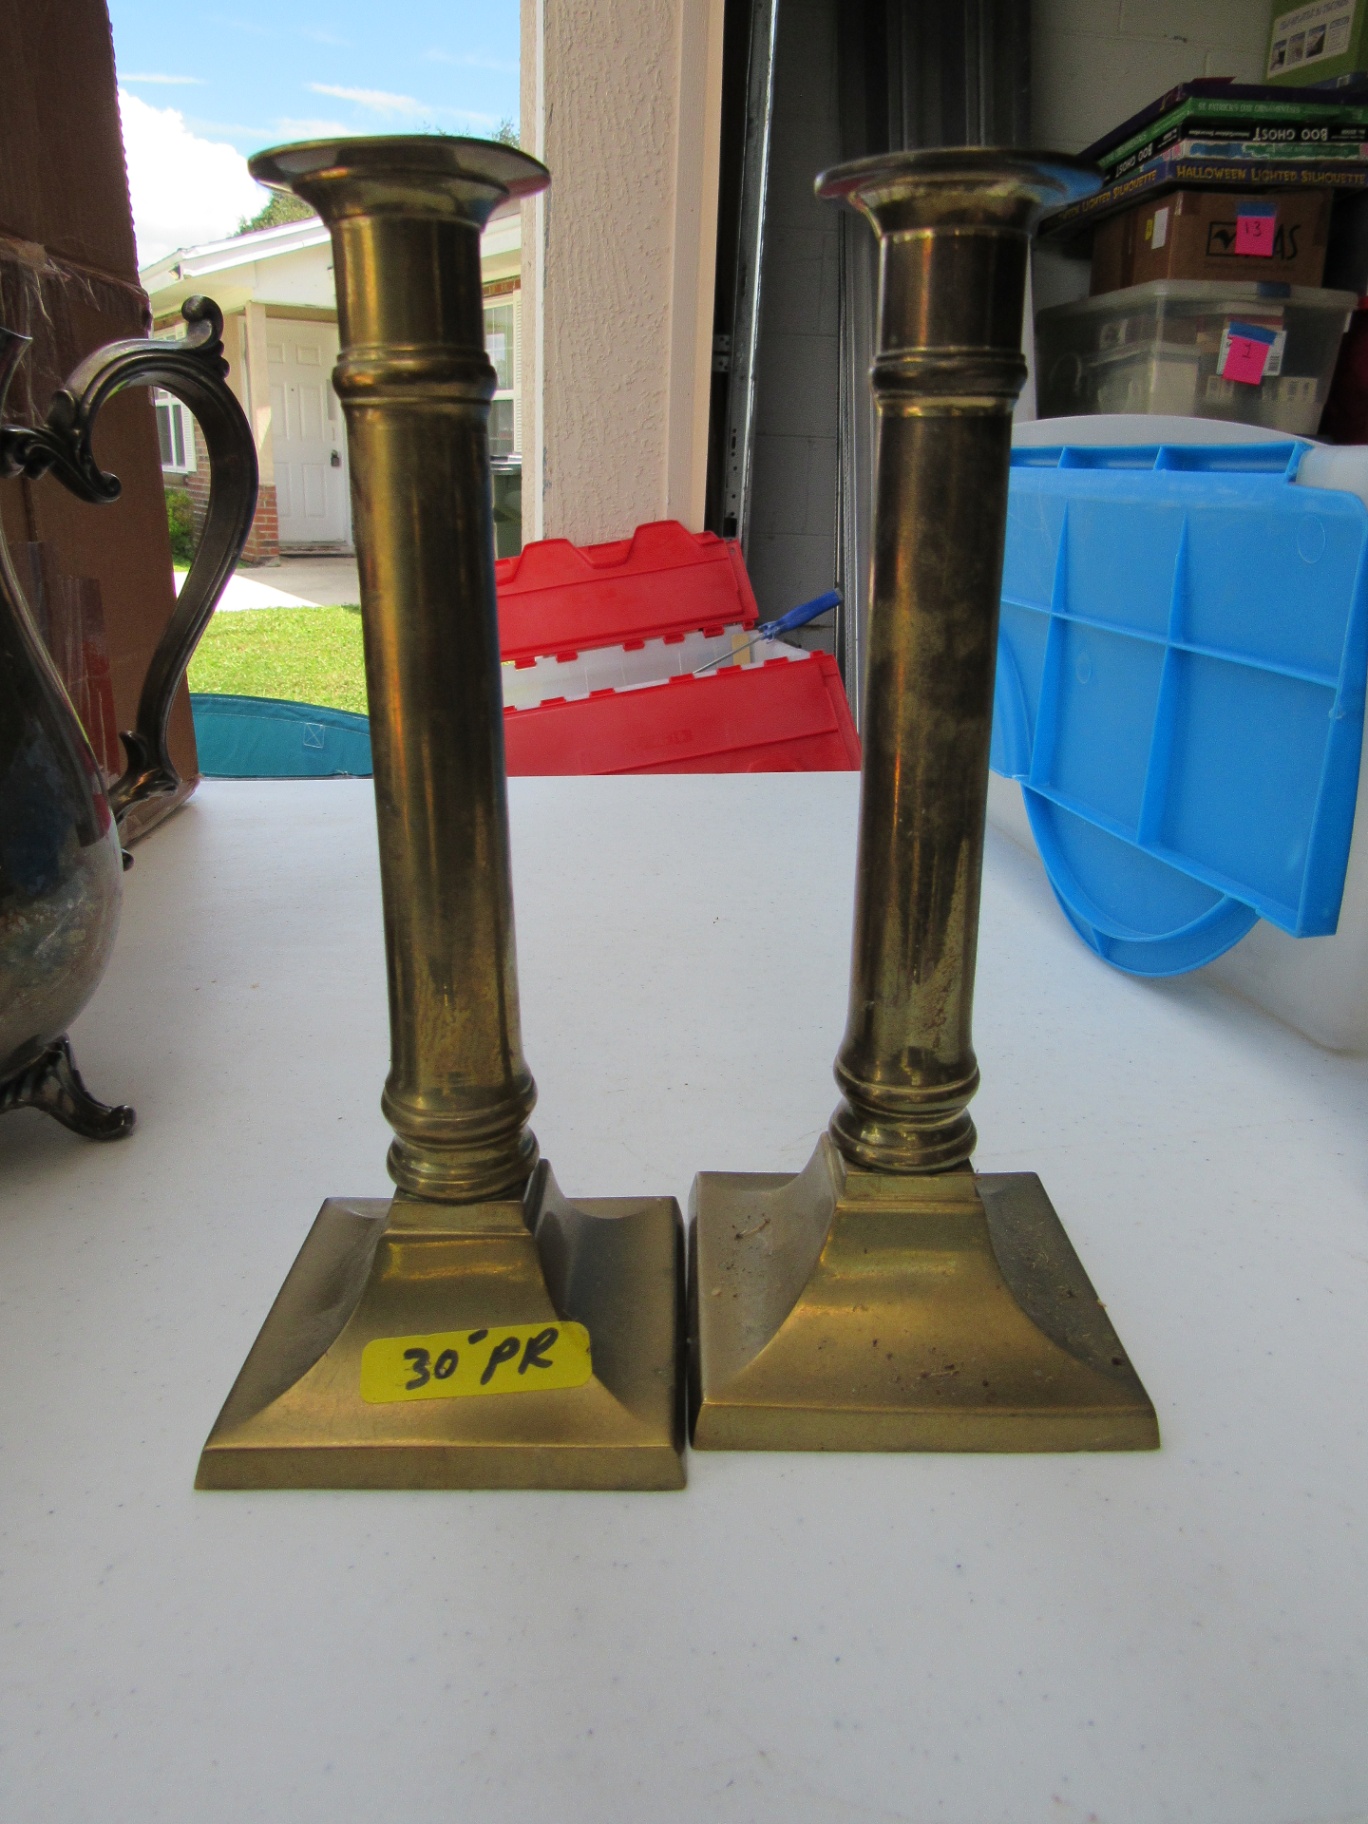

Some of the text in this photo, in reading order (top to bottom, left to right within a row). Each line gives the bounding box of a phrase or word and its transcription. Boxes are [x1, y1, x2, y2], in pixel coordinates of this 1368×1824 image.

[1253, 127, 1295, 141] GHOST
[1301, 127, 1328, 141] BOO
[1176, 165, 1366, 184] HALLOWEEN LIGHTED SILHOUETTE
[1244, 220, 1262, 237] 13
[480, 1327, 559, 1385] PR
